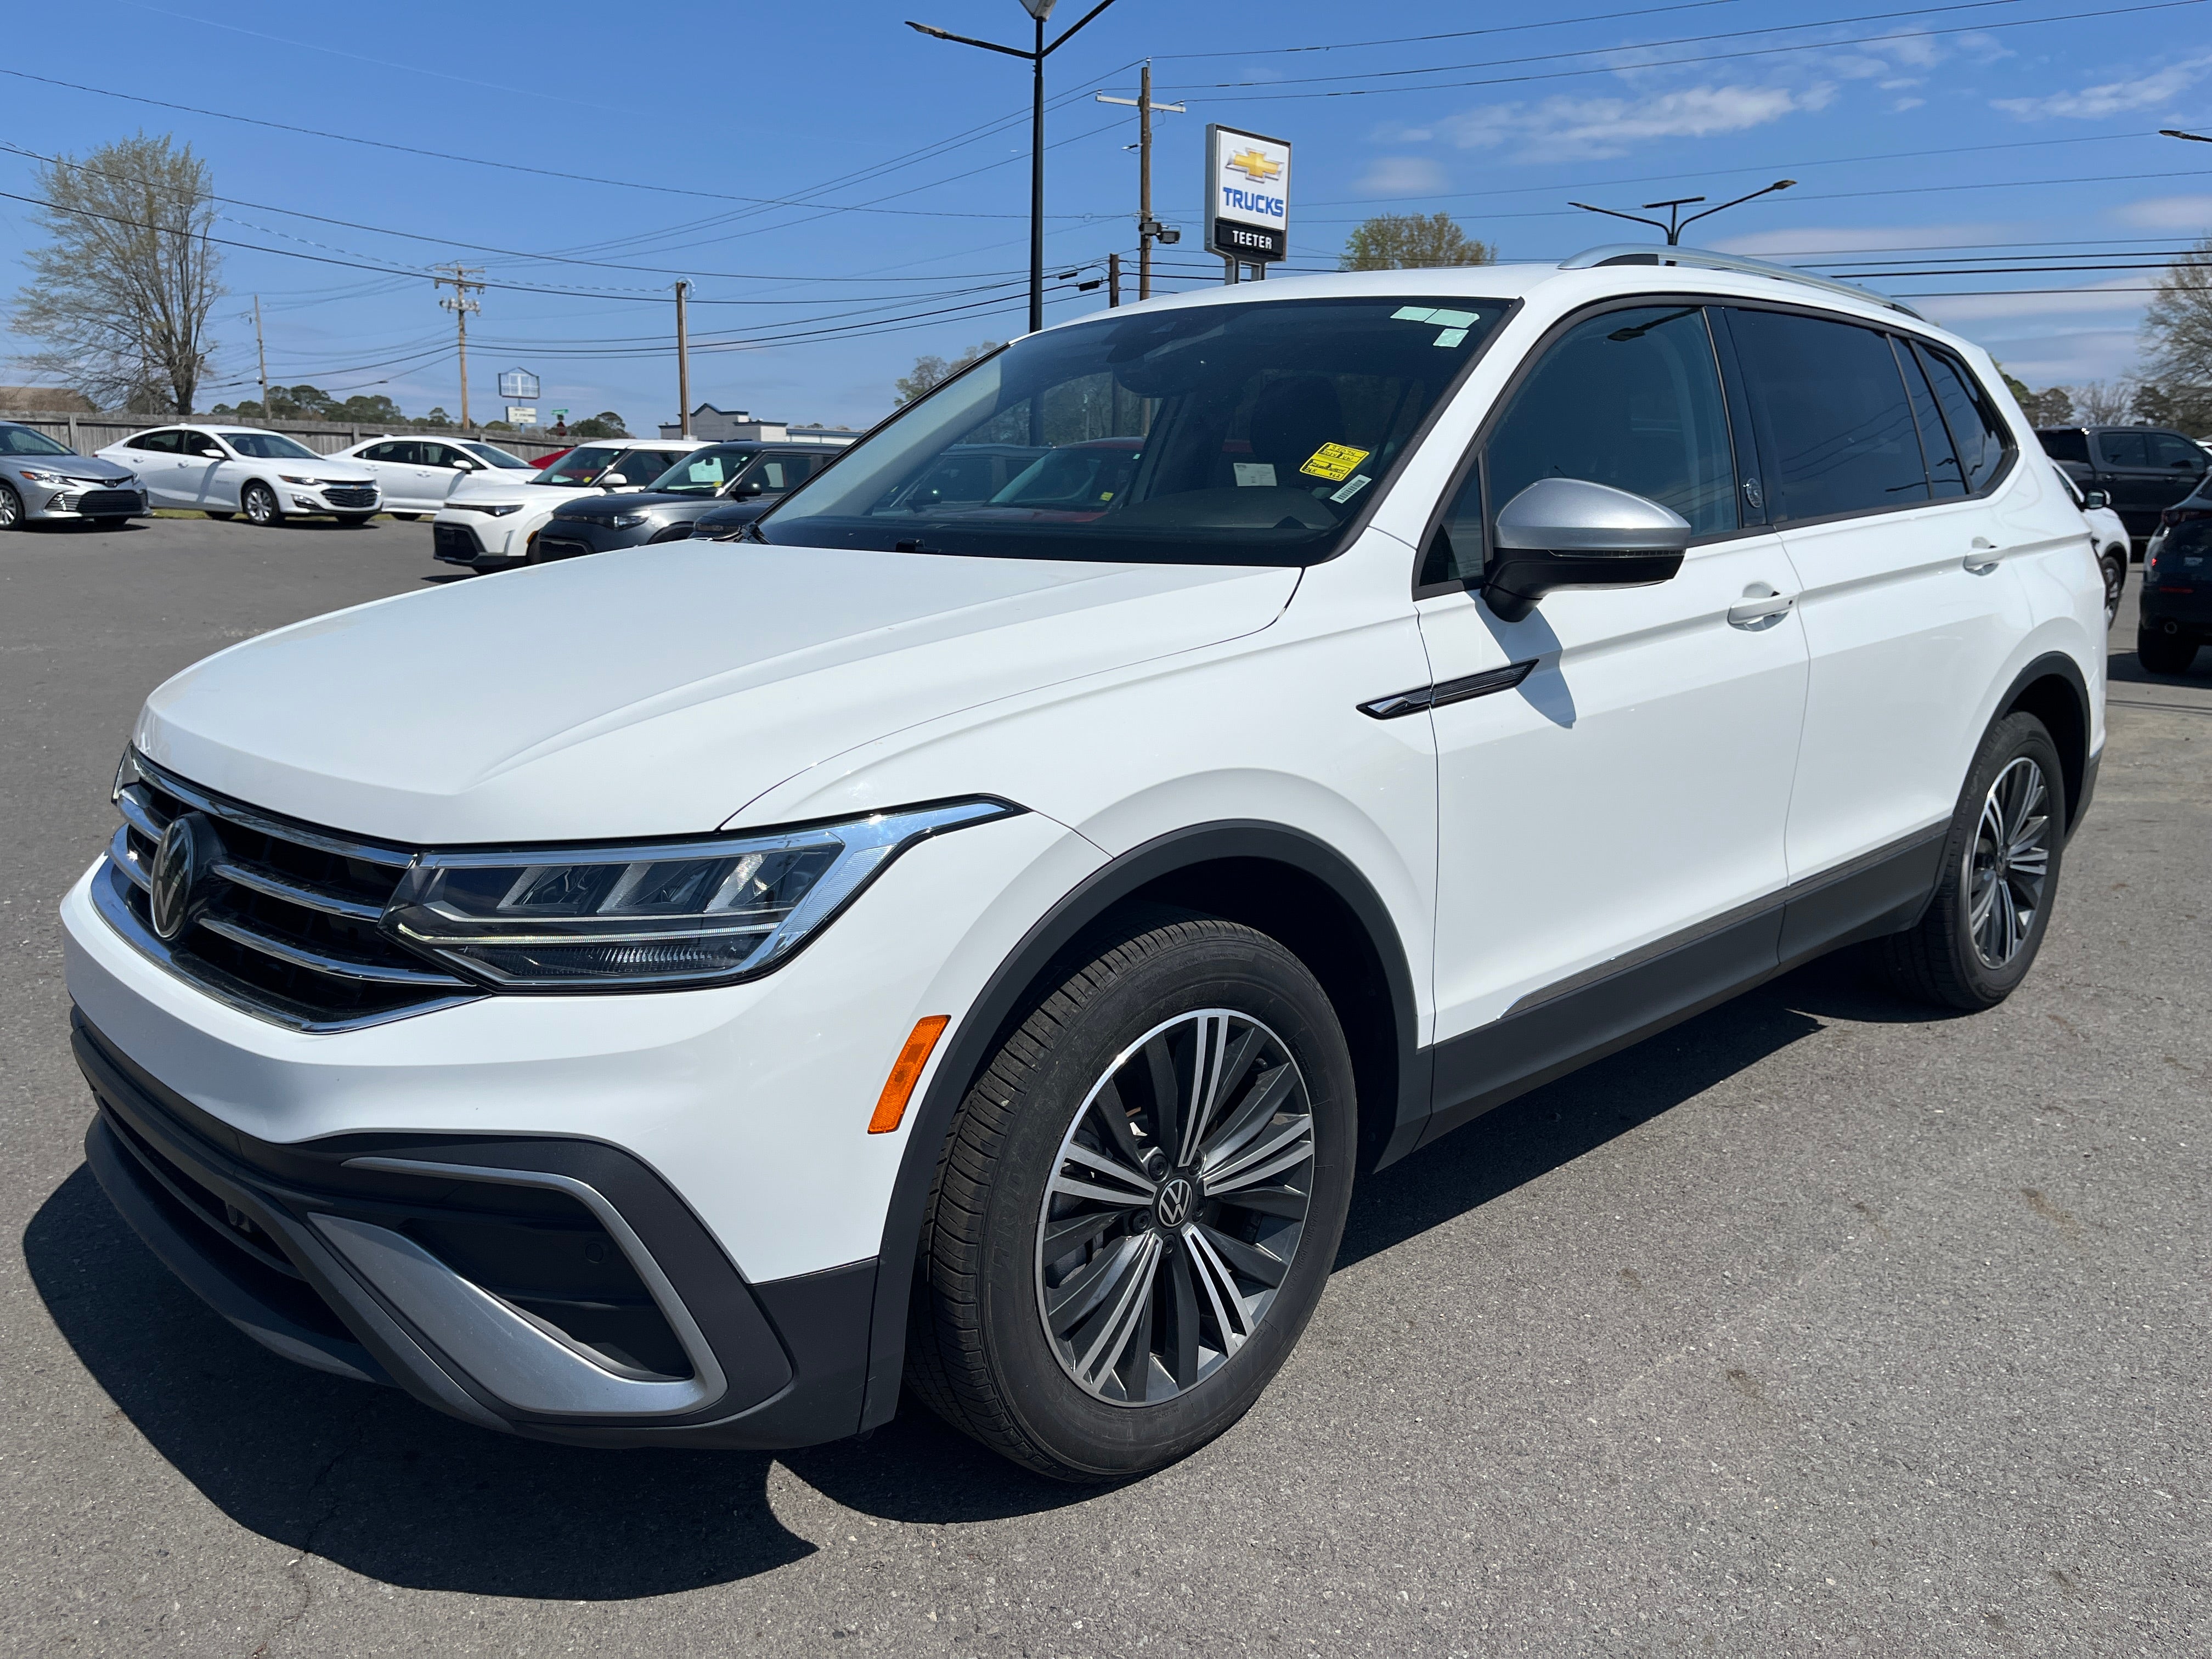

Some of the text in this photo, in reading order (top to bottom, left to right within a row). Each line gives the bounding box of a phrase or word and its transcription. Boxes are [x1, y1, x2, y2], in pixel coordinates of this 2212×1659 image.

[1223, 187, 1284, 217] TRUCKS
[1232, 230, 1272, 250] TEETER
[1160, 1180, 1191, 1224] VW
